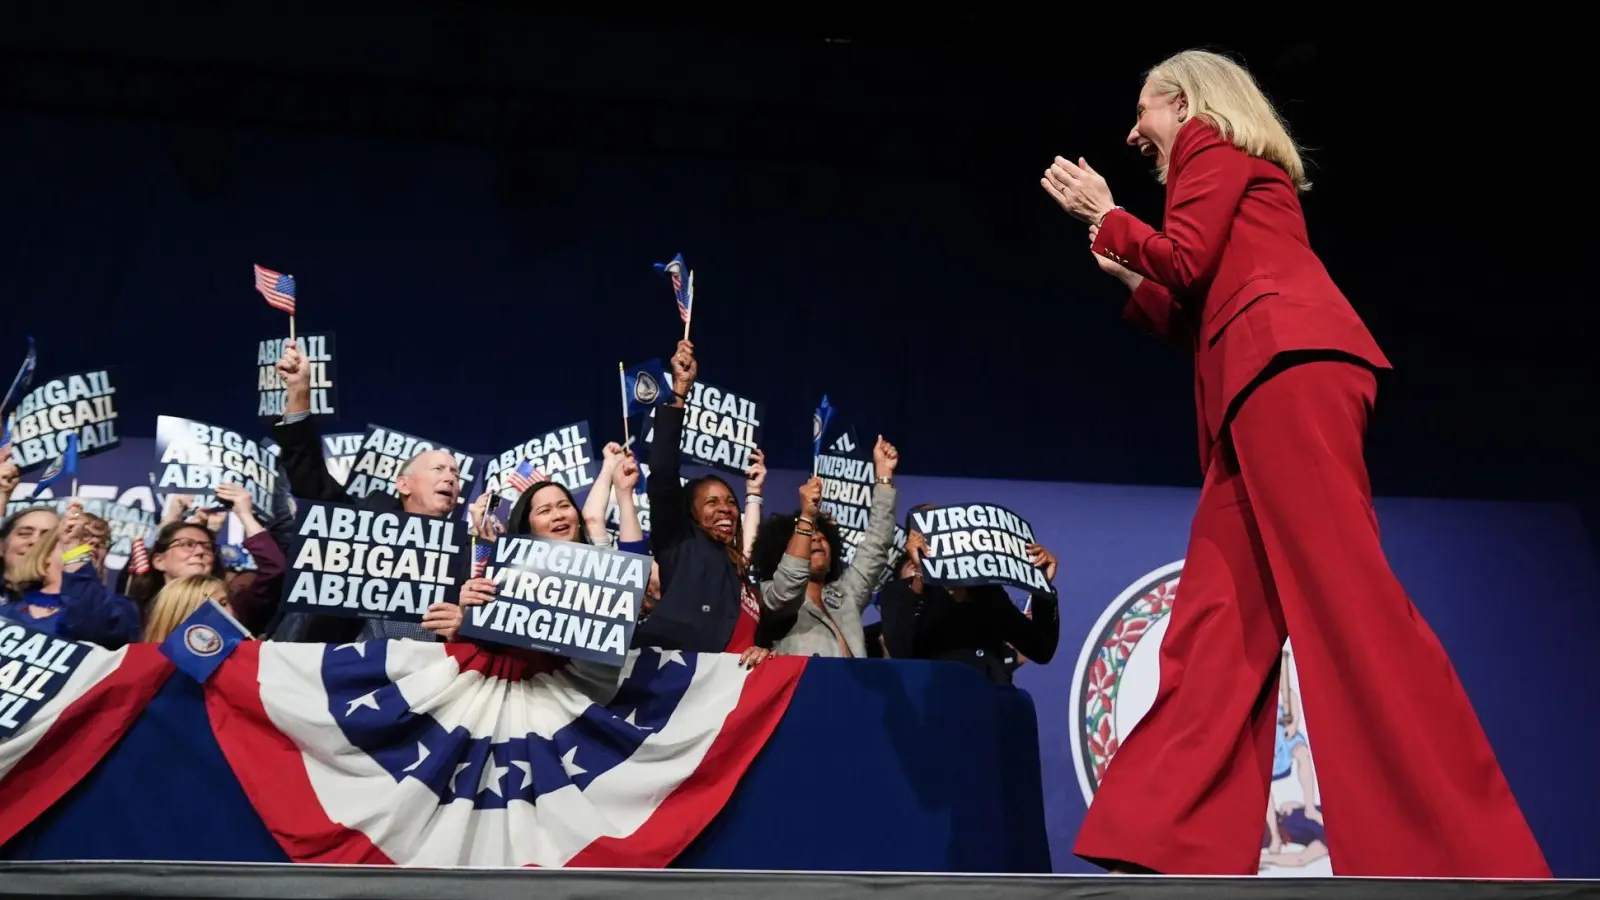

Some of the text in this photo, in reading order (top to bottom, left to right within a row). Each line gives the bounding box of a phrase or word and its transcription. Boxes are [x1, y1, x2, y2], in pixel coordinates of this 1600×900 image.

[258, 362, 333, 391] ABIIL
[258, 388, 335, 417] ABIIL
[650, 404, 758, 449] IGAIL
[188, 422, 280, 477] BIGAIL
[363, 428, 475, 482] ABIIL
[485, 425, 588, 481] ABIGAIL
[485, 444, 591, 495] ABGAIL
[645, 427, 752, 472] IGAIL
[821, 478, 873, 508] VIRGI
[298, 504, 461, 554] ABIGAIL
[912, 504, 1037, 545] VIRGINIA
[292, 537, 456, 586] ABIGAIL
[495, 536, 644, 590] VIRGINIA
[921, 553, 1052, 594] VIRGINIA
[484, 565, 635, 622] VIRGINIA
[0, 620, 79, 674] GAIL
[472, 599, 626, 657] VIRGINIA
